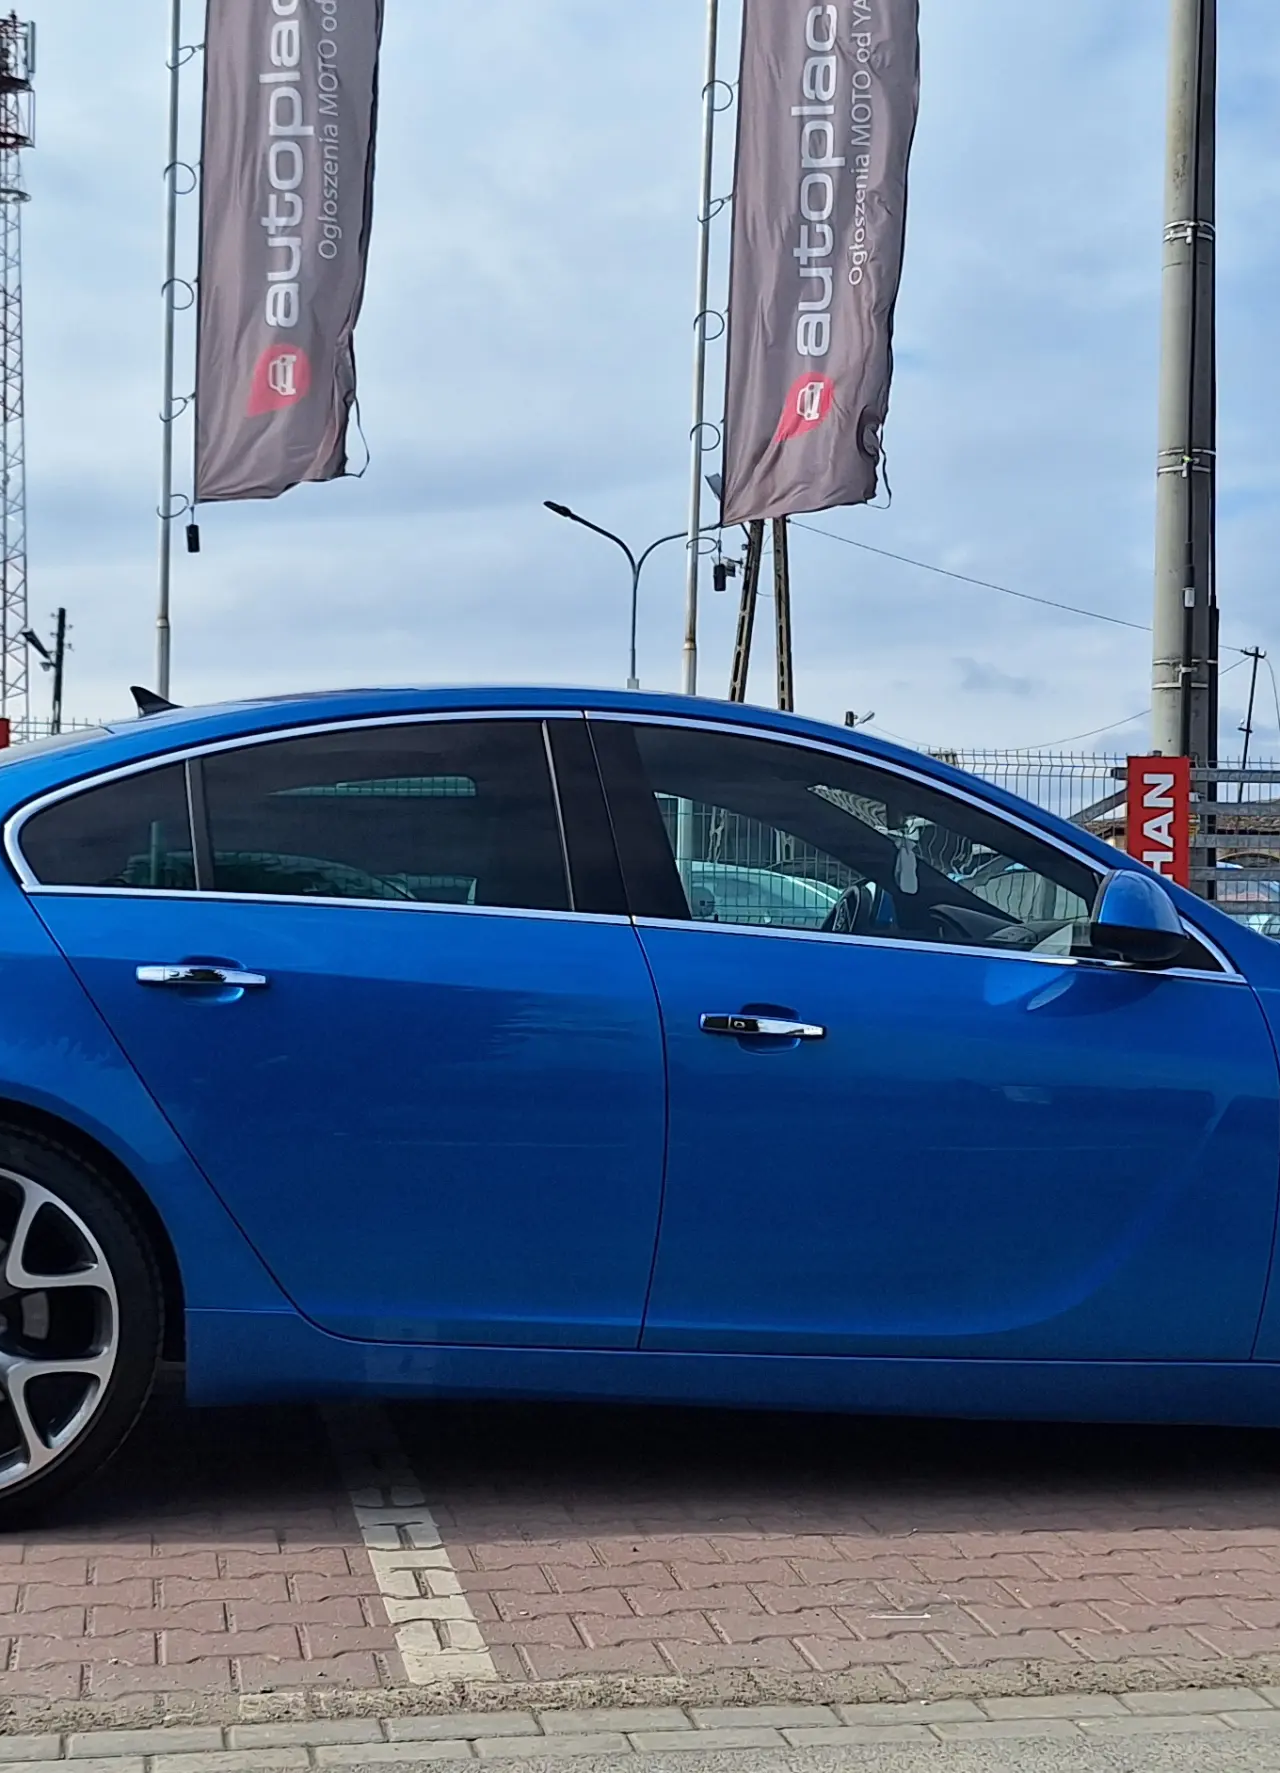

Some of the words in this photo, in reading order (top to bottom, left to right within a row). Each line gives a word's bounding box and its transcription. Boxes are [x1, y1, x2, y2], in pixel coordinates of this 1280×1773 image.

[317, 38, 339, 117] MOTO
[851, 32, 872, 63] od
[850, 70, 873, 148] MOTO
[318, 122, 342, 261] Ogłoszenia
[791, 4, 846, 357] autoplac
[848, 154, 871, 286] Ogłoszenia
